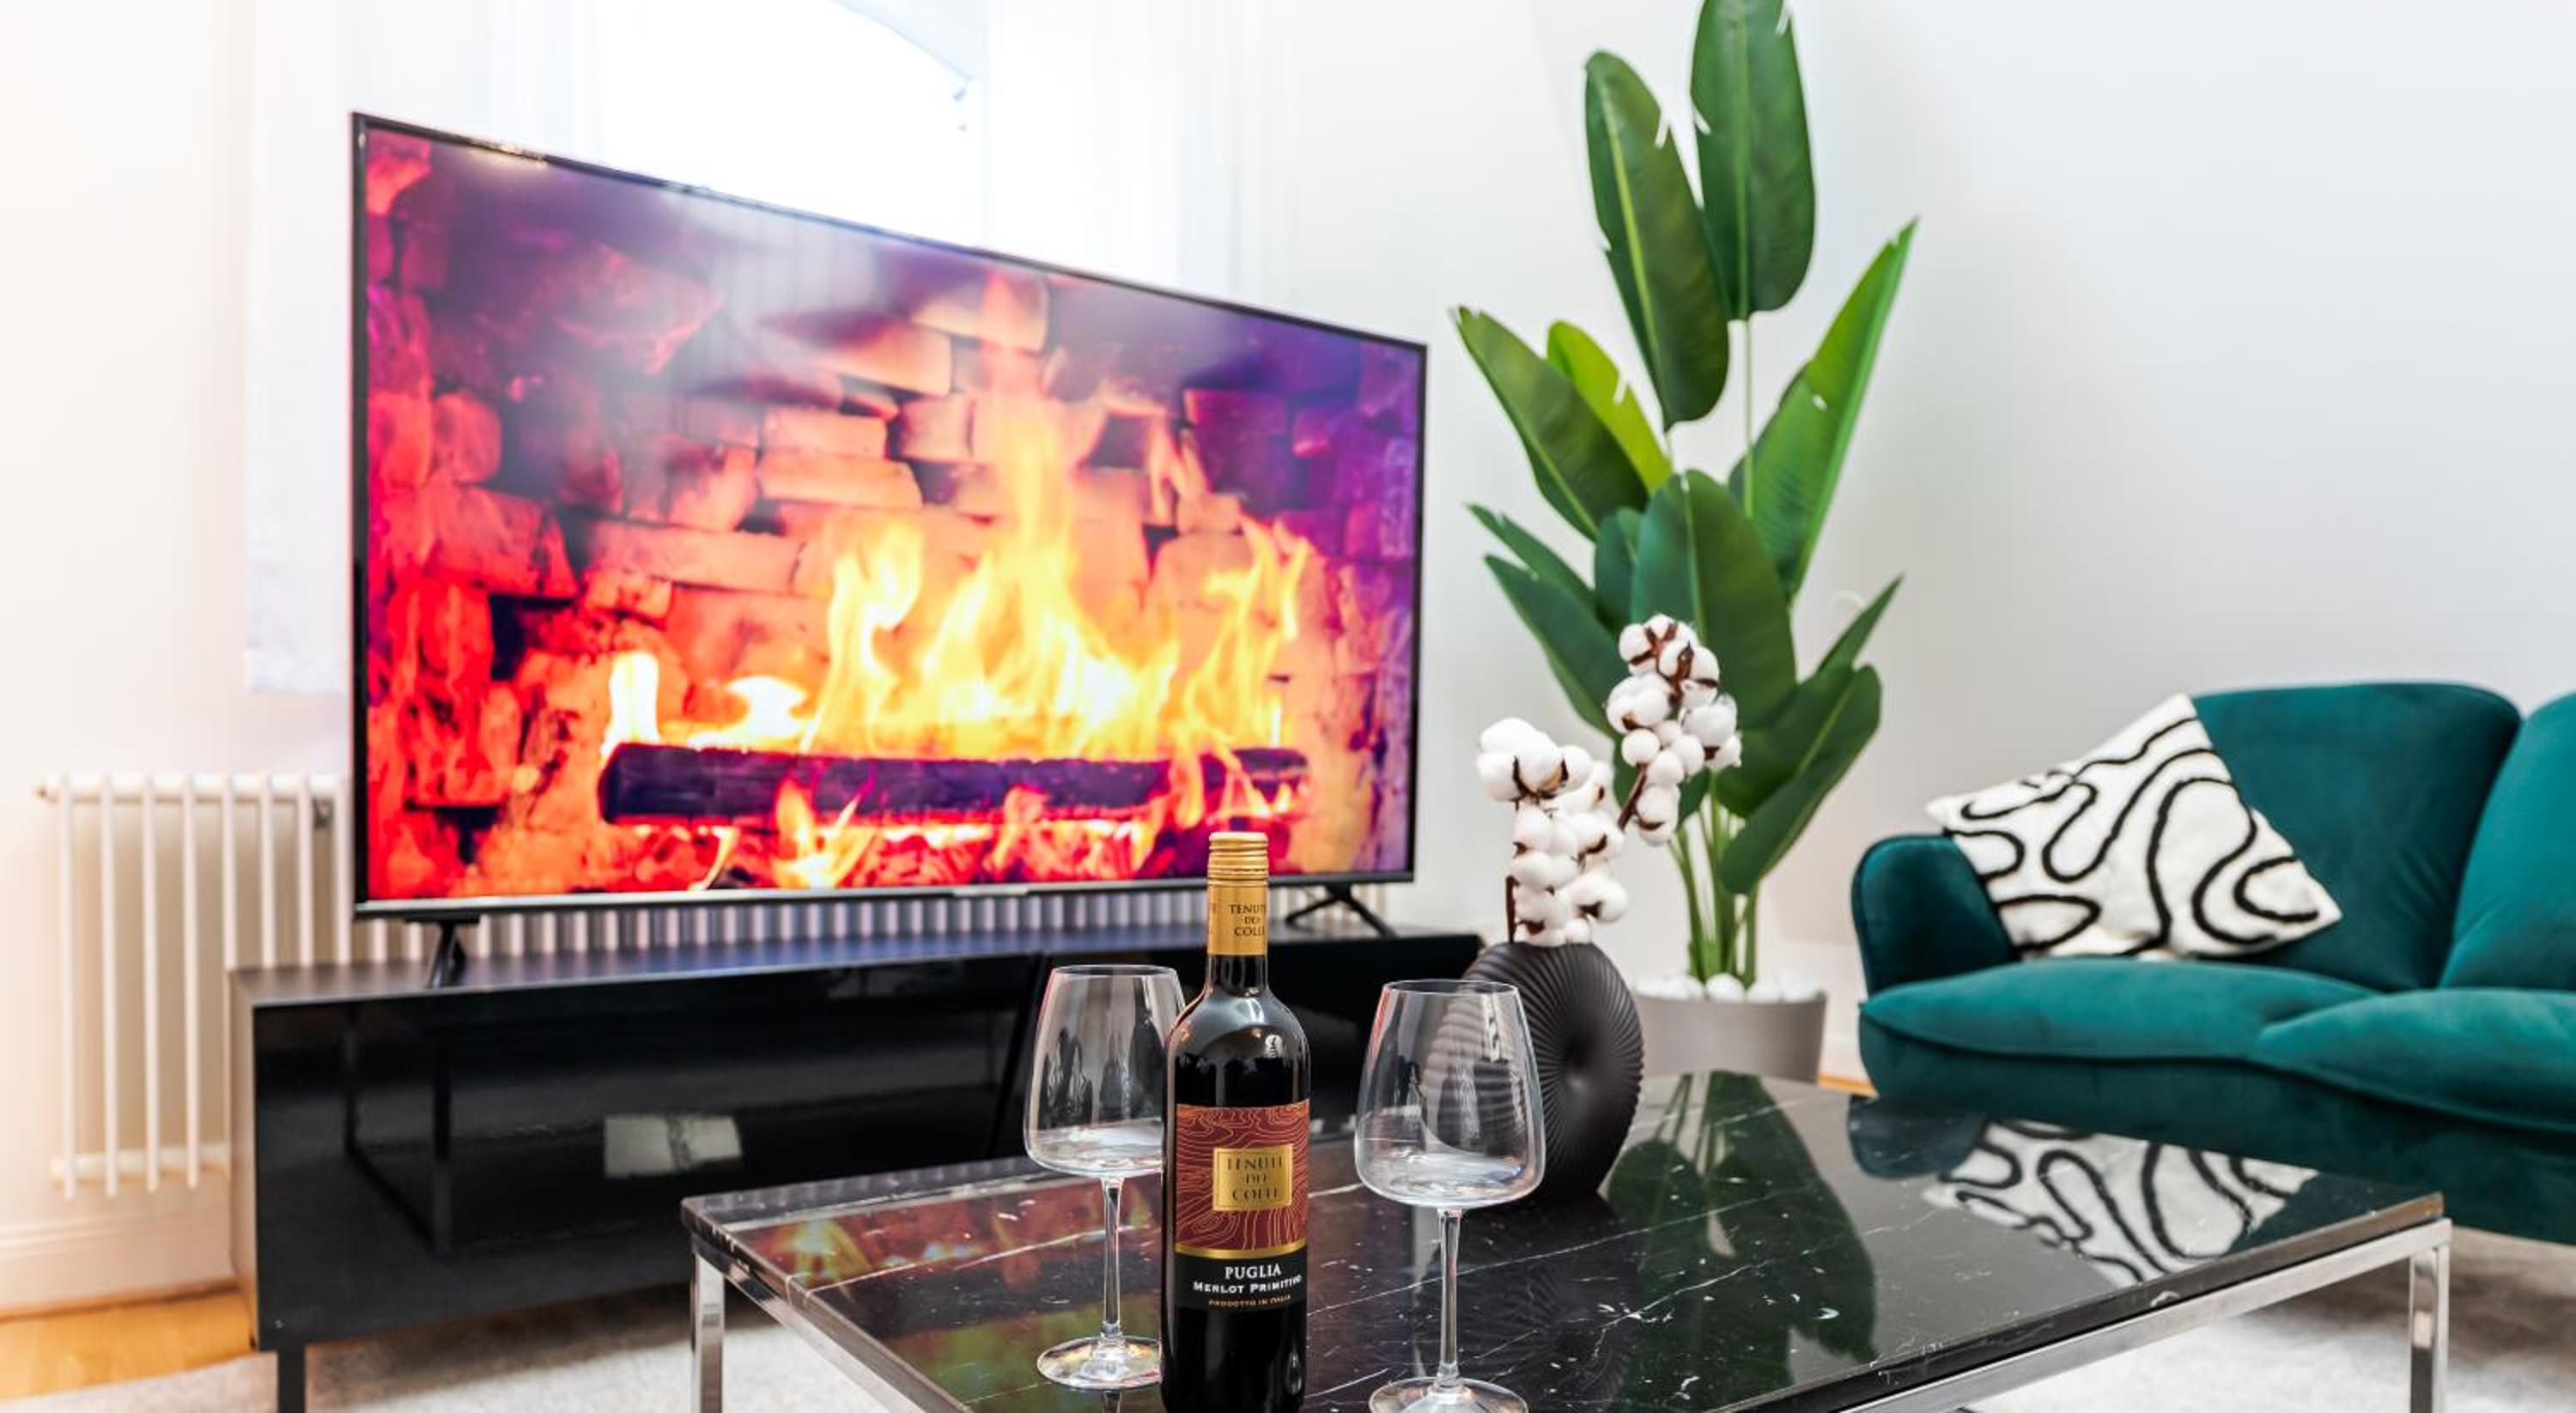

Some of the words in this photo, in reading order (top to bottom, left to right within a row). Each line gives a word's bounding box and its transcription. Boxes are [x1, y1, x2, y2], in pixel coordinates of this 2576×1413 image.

[1224, 1263, 1282, 1280] PUGLIA
[1193, 1280, 1244, 1295] MERLOT
[1249, 1274, 1303, 1294] PRIMITIVO
[1208, 1299, 1256, 1307] PRODOTTO
